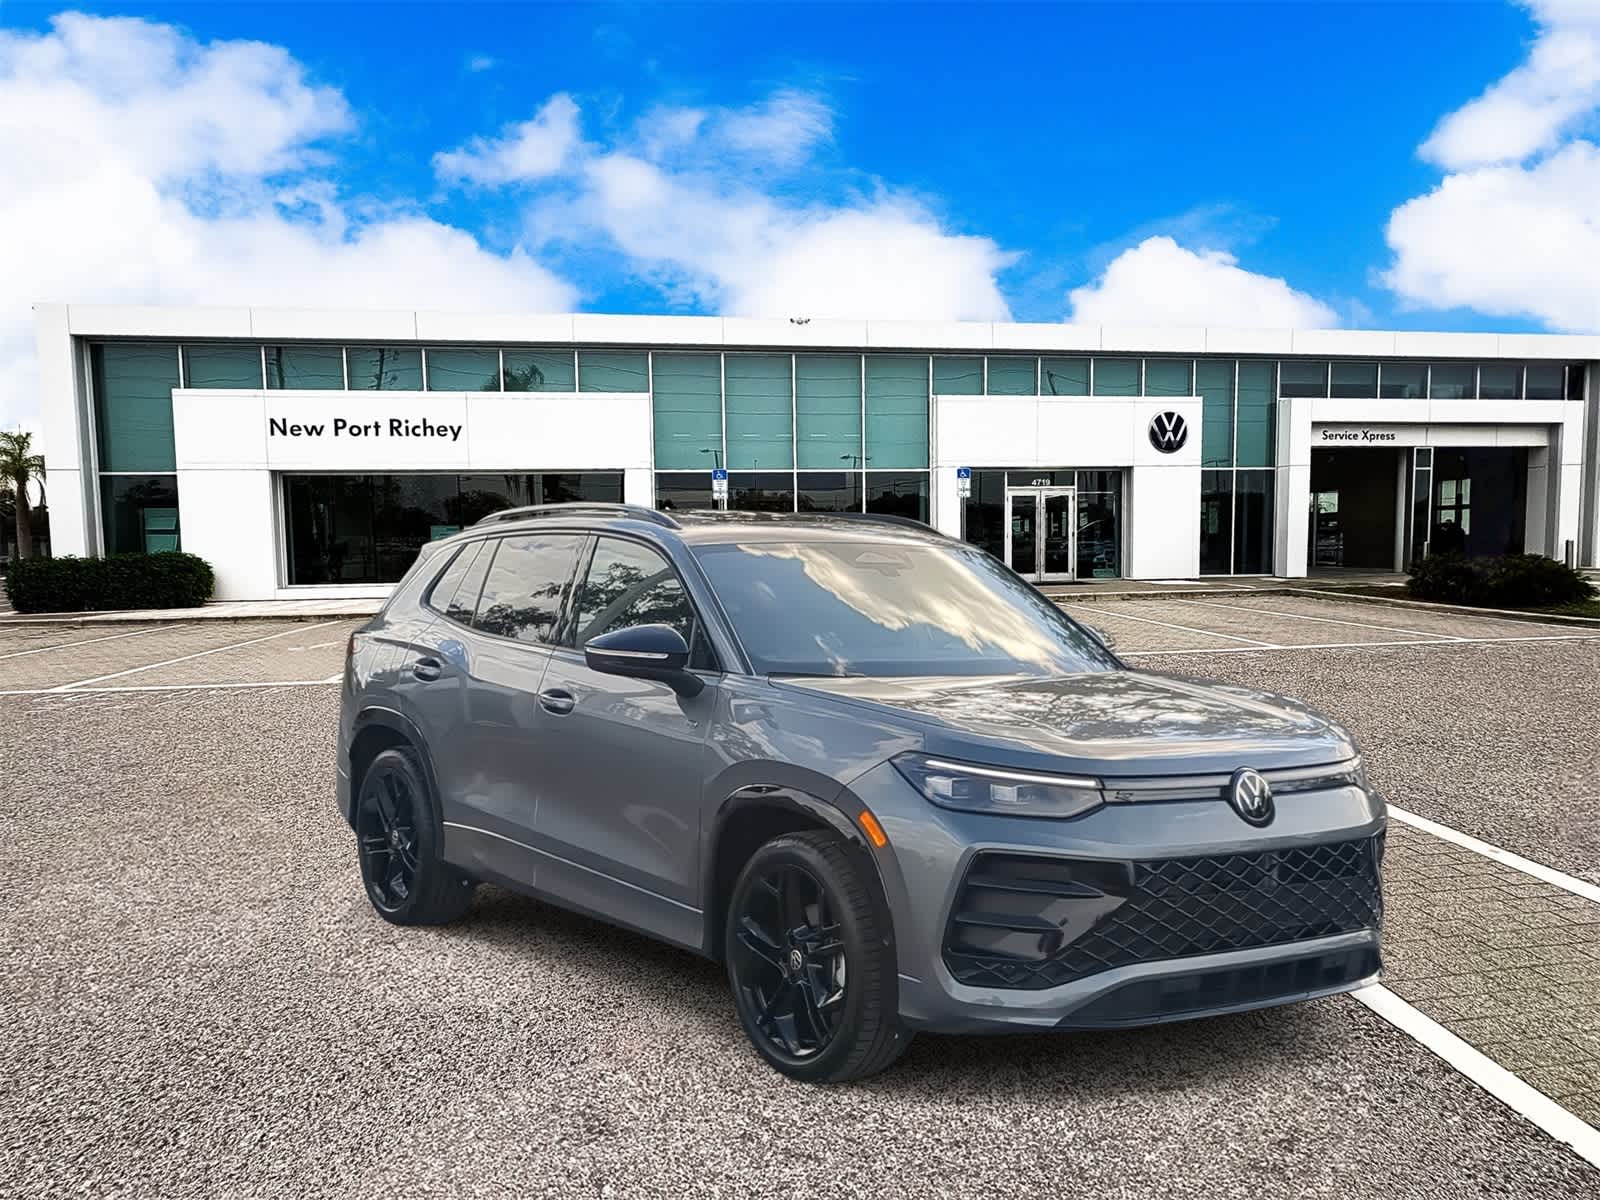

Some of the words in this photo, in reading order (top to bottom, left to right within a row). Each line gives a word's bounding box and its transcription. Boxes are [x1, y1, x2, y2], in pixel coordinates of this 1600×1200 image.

[269, 417, 325, 437] New
[333, 417, 382, 437] Port
[388, 417, 463, 442] Richey
[1321, 430, 1359, 441] Service
[1361, 429, 1396, 443] Xpress
